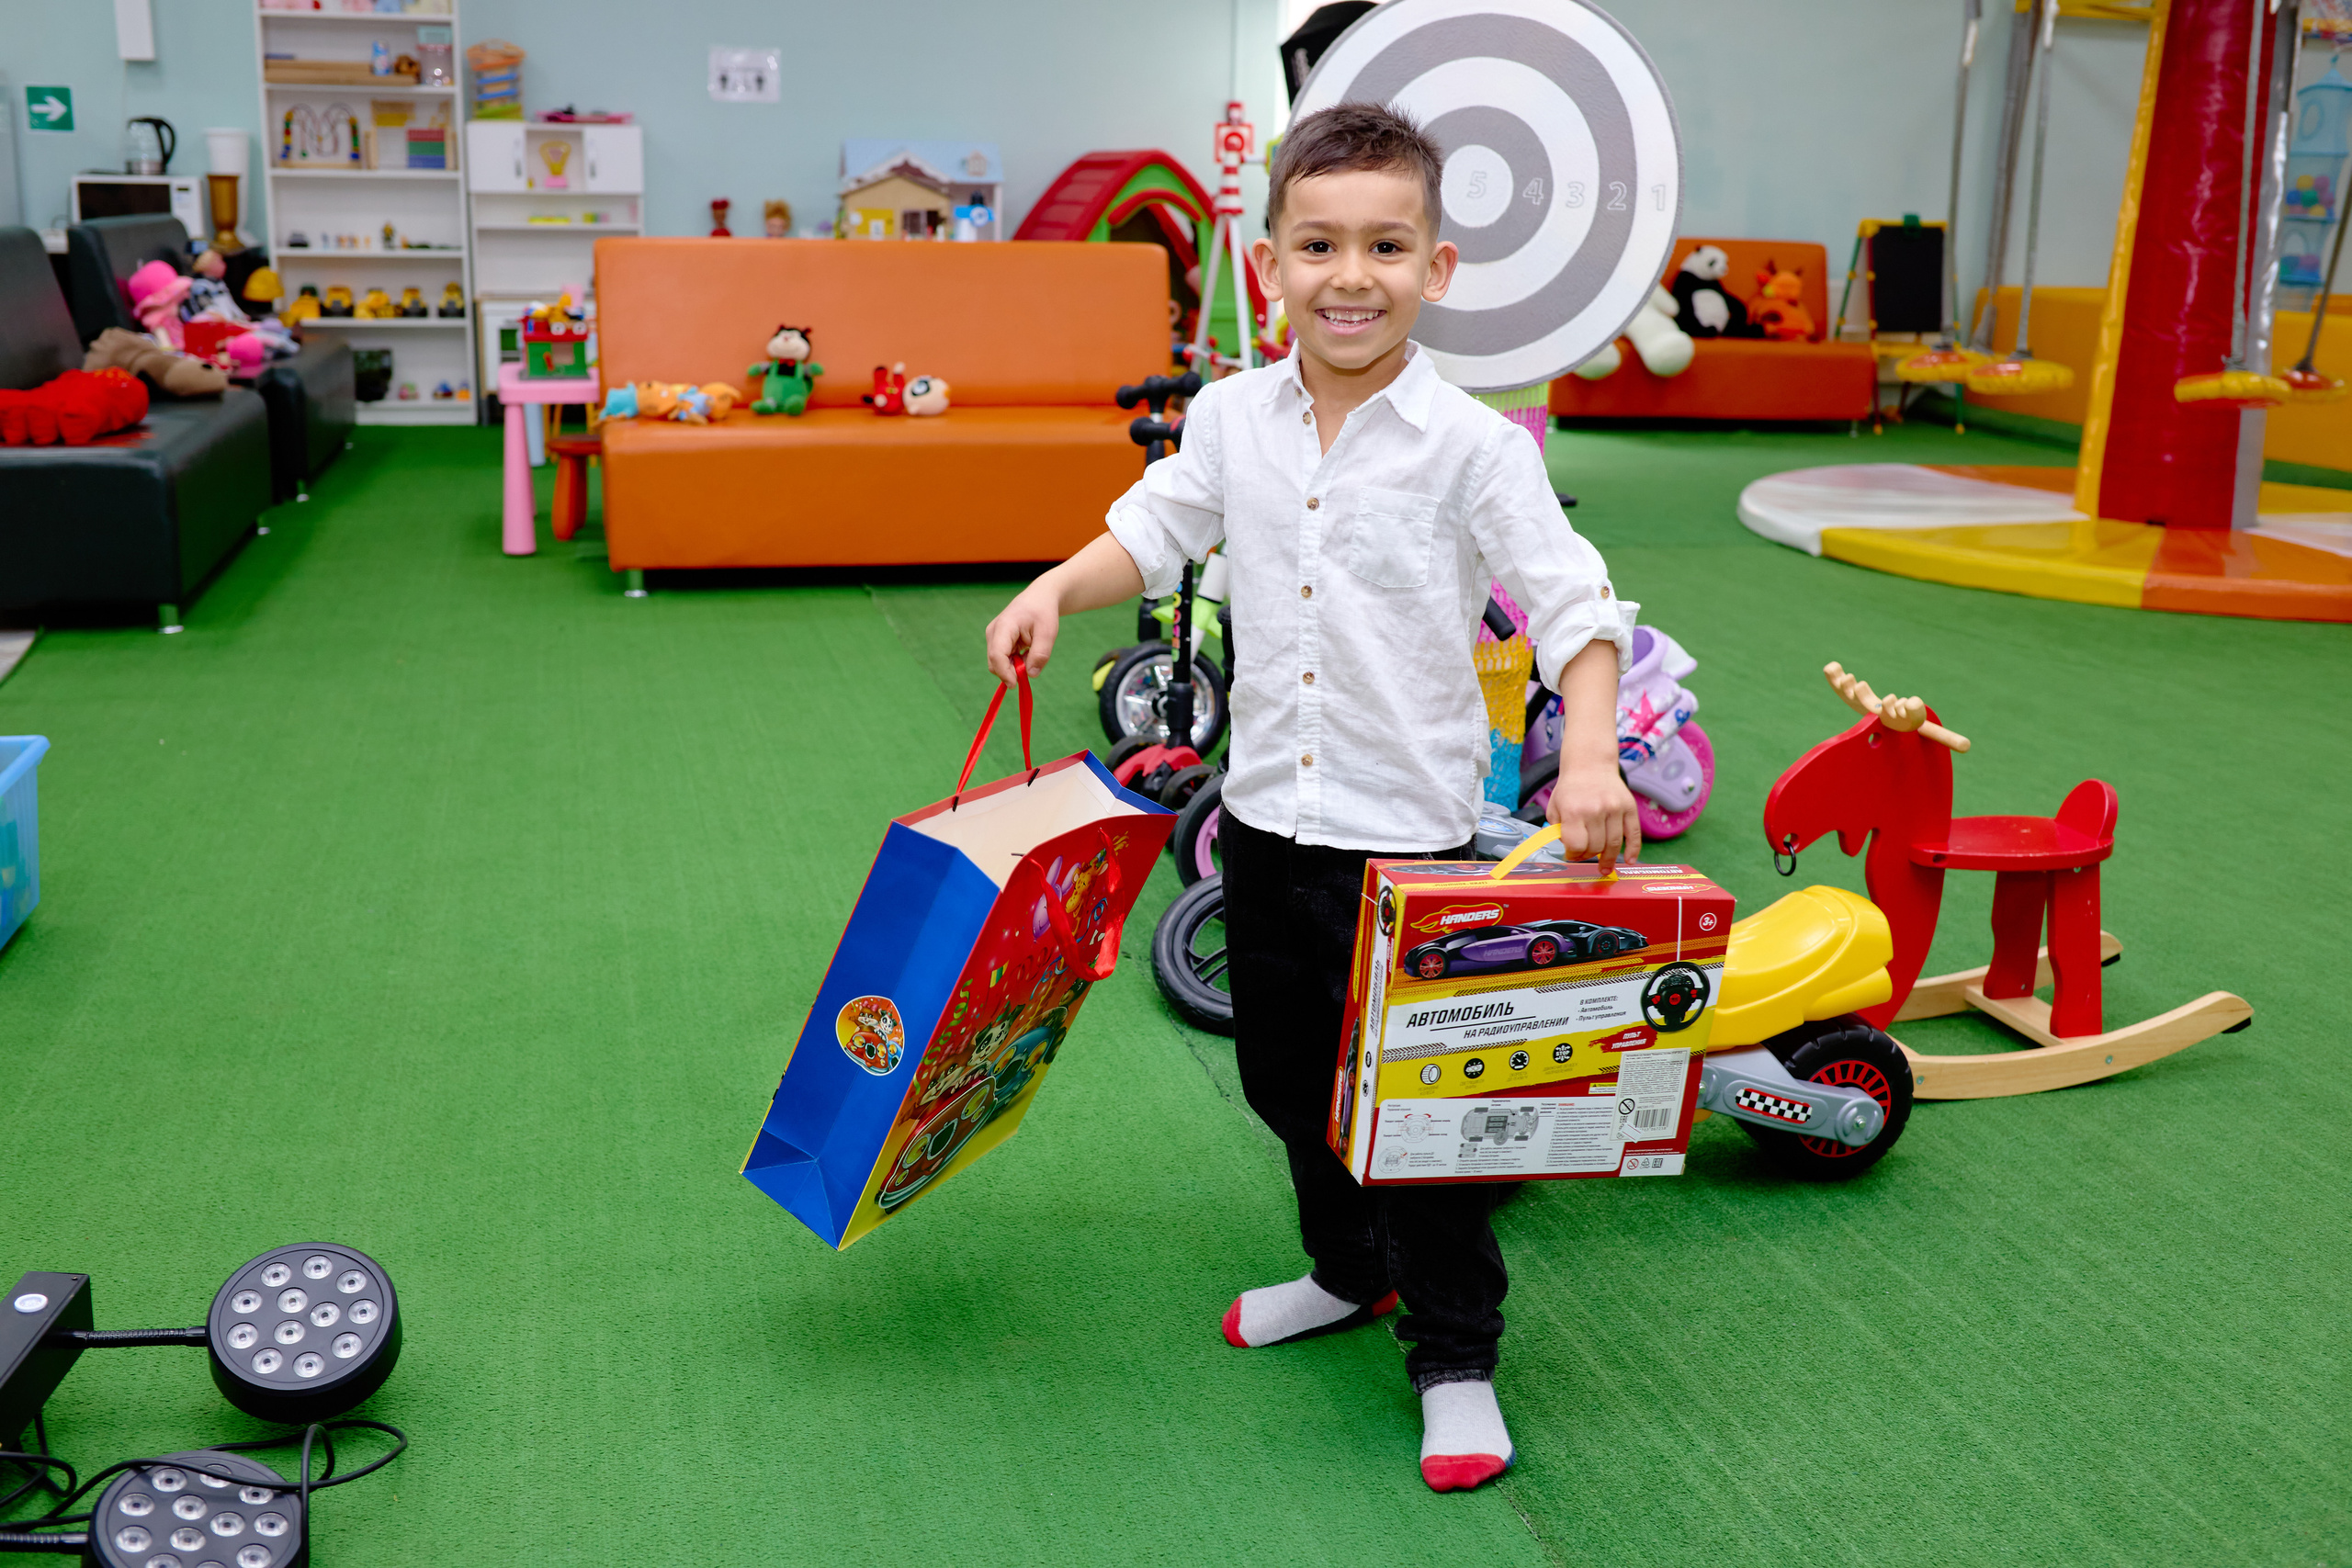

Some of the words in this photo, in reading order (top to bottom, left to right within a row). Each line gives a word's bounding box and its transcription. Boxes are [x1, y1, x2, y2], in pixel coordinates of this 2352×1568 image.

[1466, 171, 1487, 199] 5
[1522, 177, 1544, 206] 4
[1566, 181, 1586, 209] 3
[1607, 181, 1627, 211] 2
[1651, 183, 1667, 211] 1
[1440, 908, 1500, 926] HANDERS
[1702, 916, 1714, 927] 3+
[1483, 945, 1523, 957] HANDERS
[1406, 1001, 1515, 1028] АВТОМОБИЛЬ
[1464, 1029, 1476, 1039] НА
[1477, 1017, 1569, 1037] РАДИОУПРАВЛЕНИИ
[1334, 1069, 1343, 1123] HANDERS
